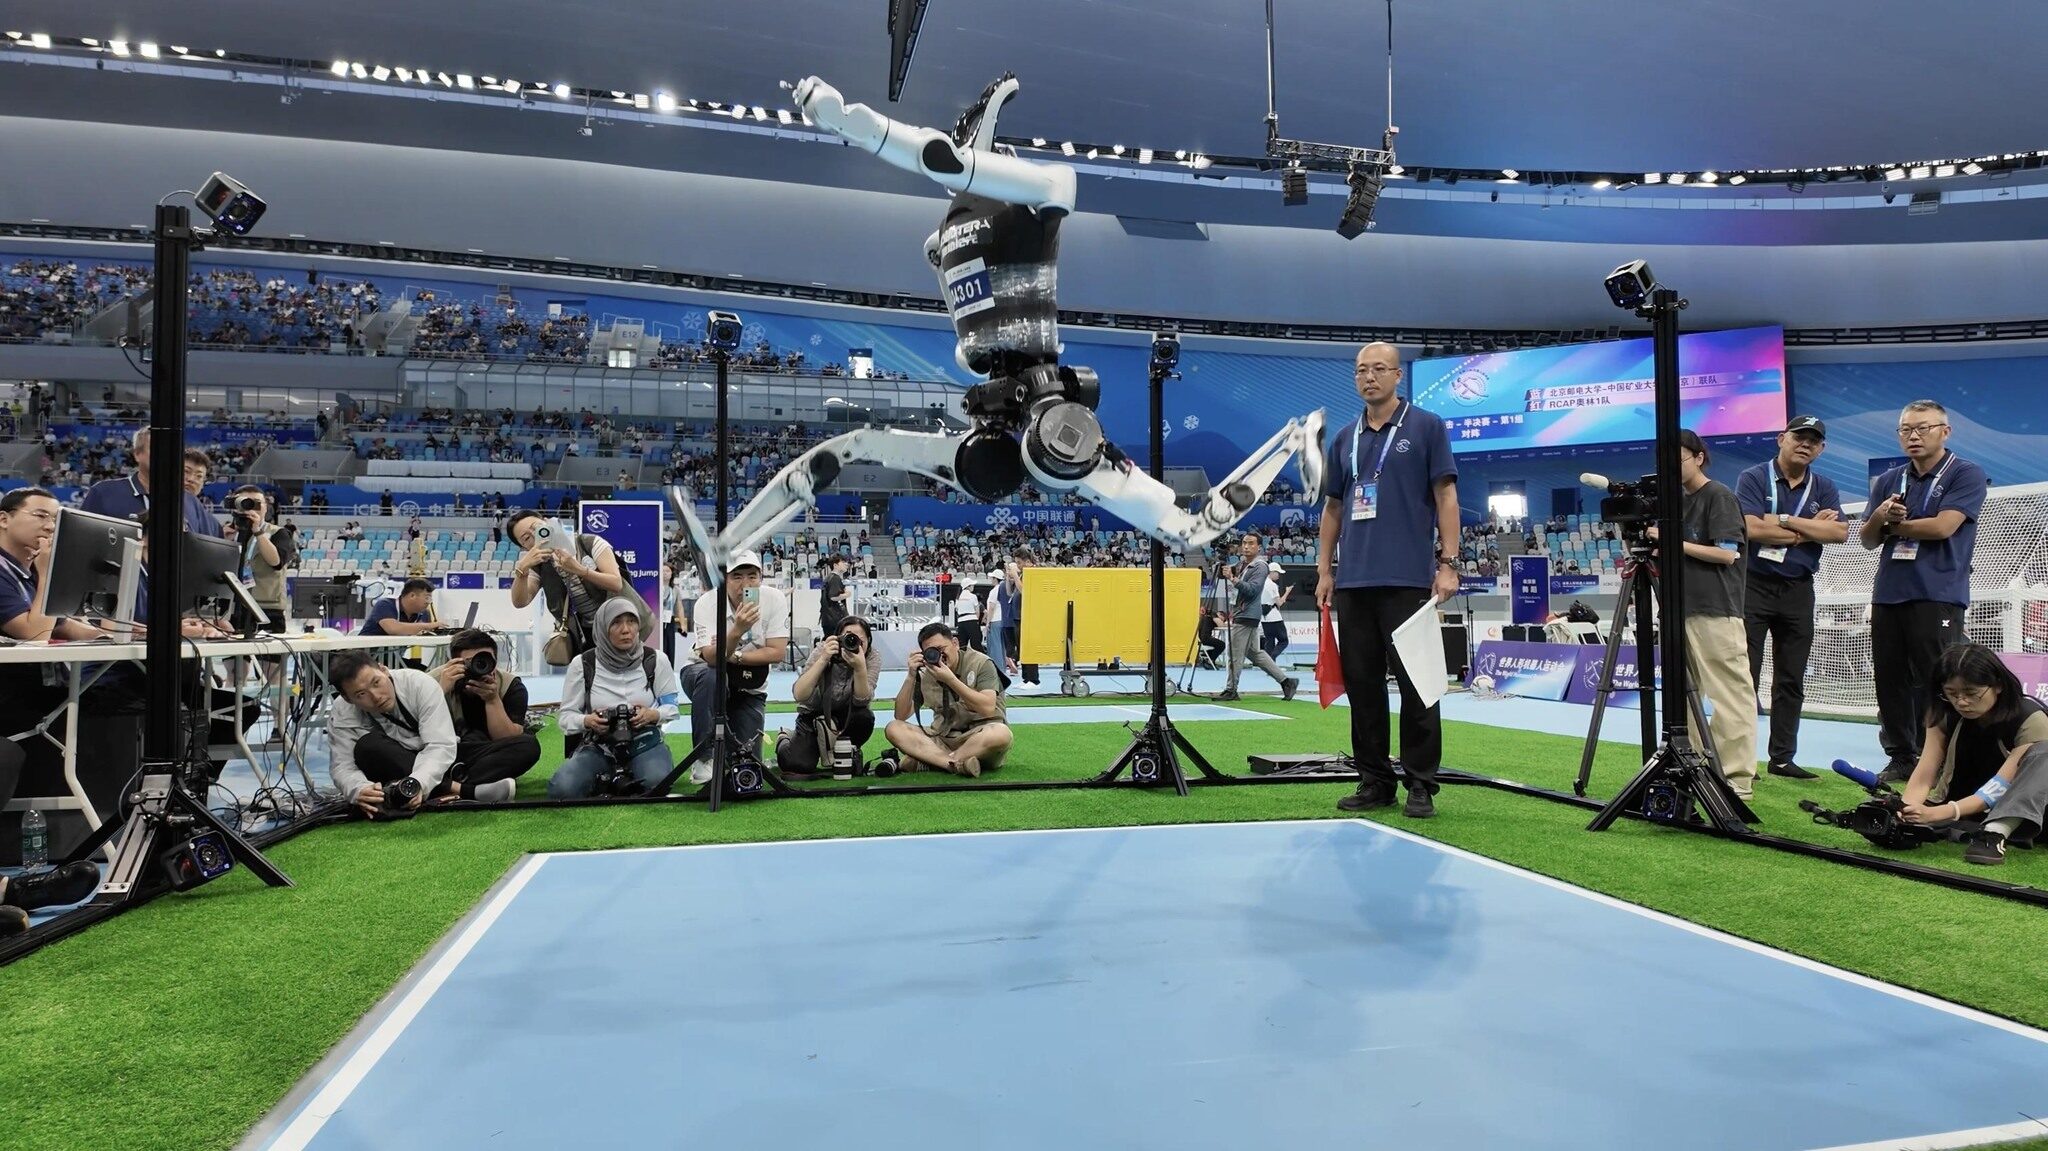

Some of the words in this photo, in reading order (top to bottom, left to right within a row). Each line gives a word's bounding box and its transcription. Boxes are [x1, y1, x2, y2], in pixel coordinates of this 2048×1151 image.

[622, 330, 638, 339] E12
[1461, 428, 1481, 439] 对阵
[302, 460, 318, 470] E4
[863, 474, 877, 482] E2
[1022, 510, 1076, 523] 中国联通
[615, 551, 636, 563] 远
[1499, 657, 1568, 672] 世界人形机器人运动会
